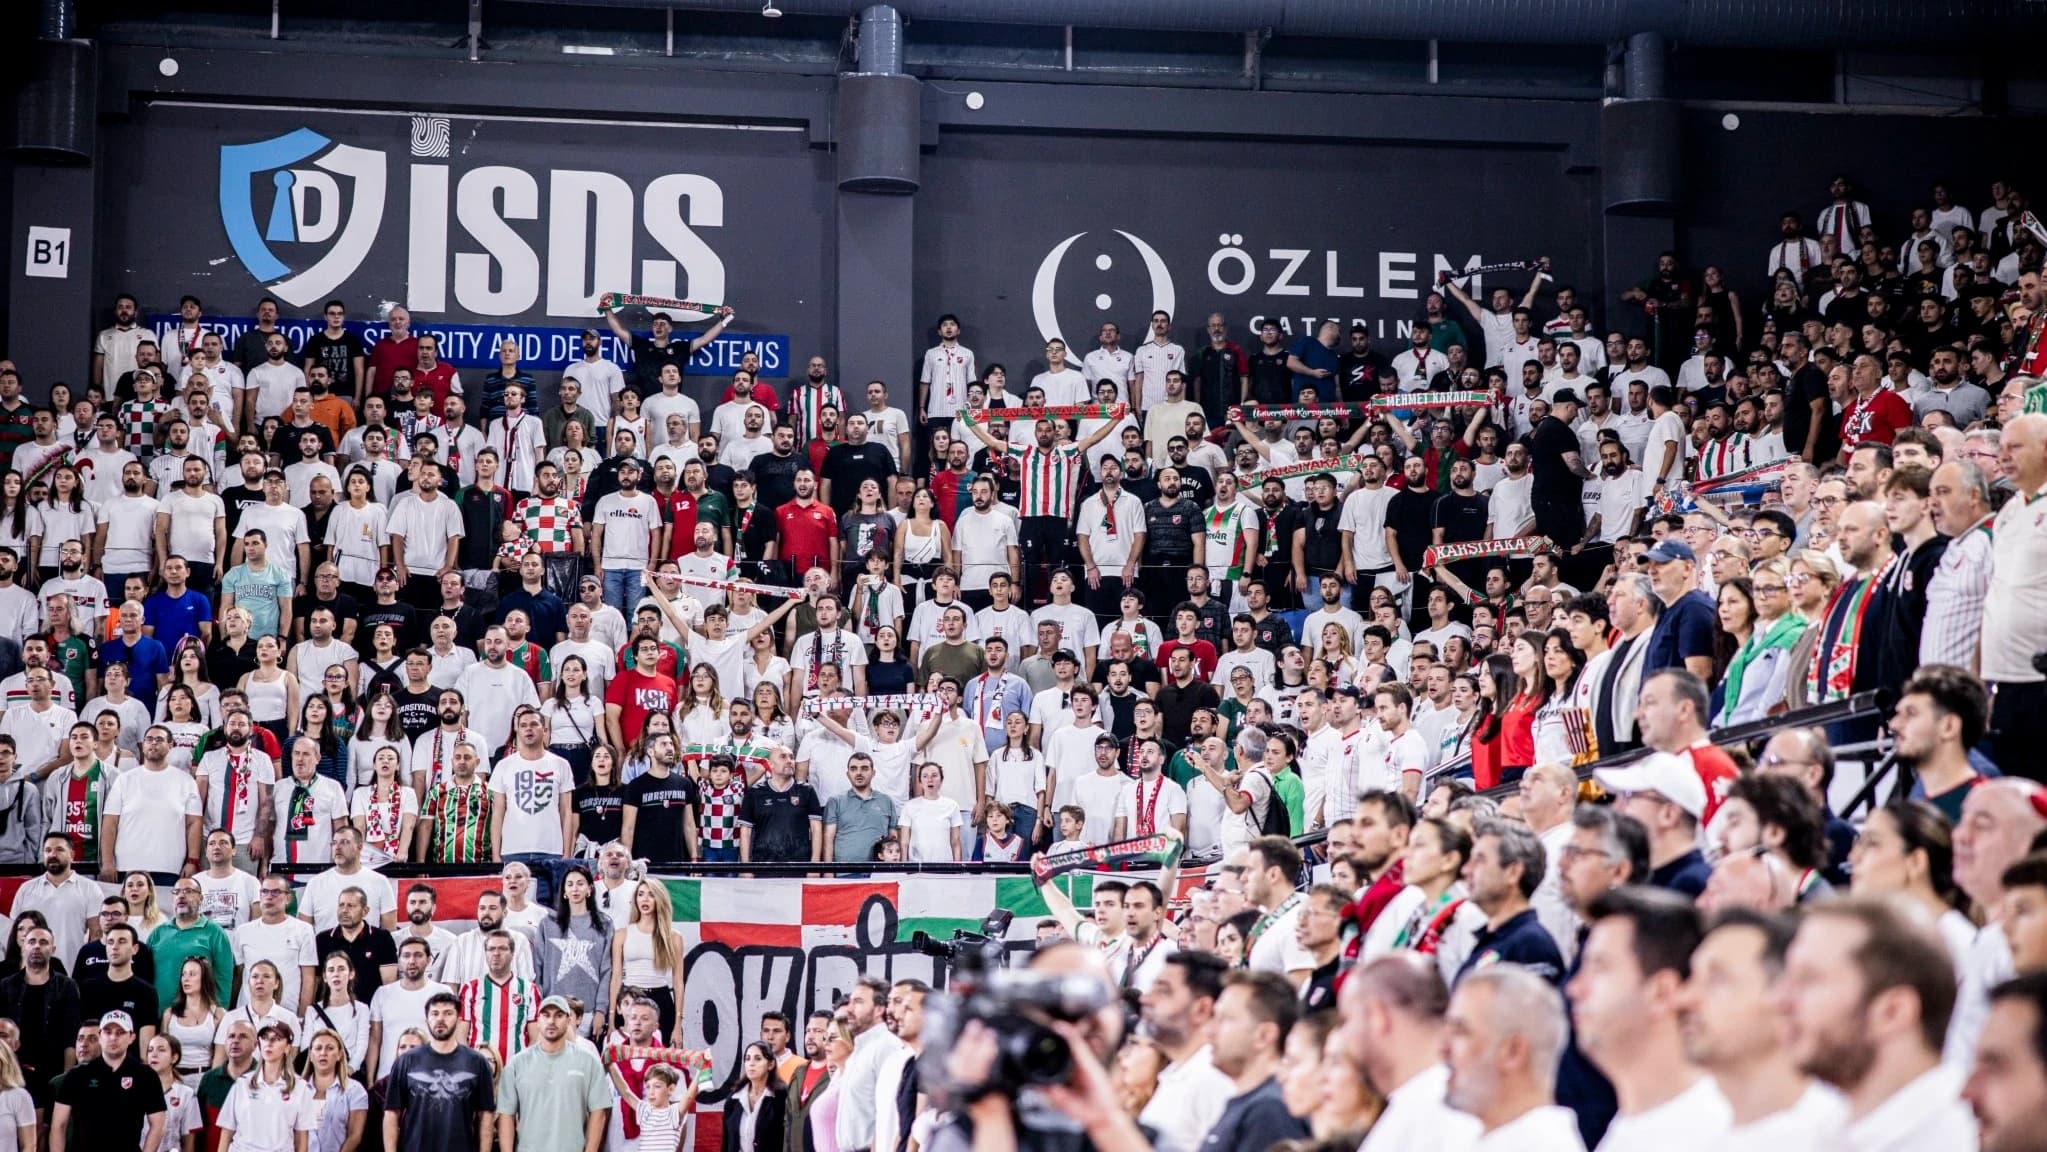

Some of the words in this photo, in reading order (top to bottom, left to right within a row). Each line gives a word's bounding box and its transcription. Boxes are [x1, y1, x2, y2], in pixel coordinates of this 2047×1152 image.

[33, 239, 66, 266] B1
[1207, 233, 1483, 300] ÖZLEM
[489, 332, 542, 362] AND
[1386, 393, 1429, 407] MEHMET
[609, 509, 643, 520] ellesse
[675, 500, 691, 512] 12
[635, 687, 669, 710] KSK
[514, 769, 533, 790] 19
[514, 790, 533, 815] 12
